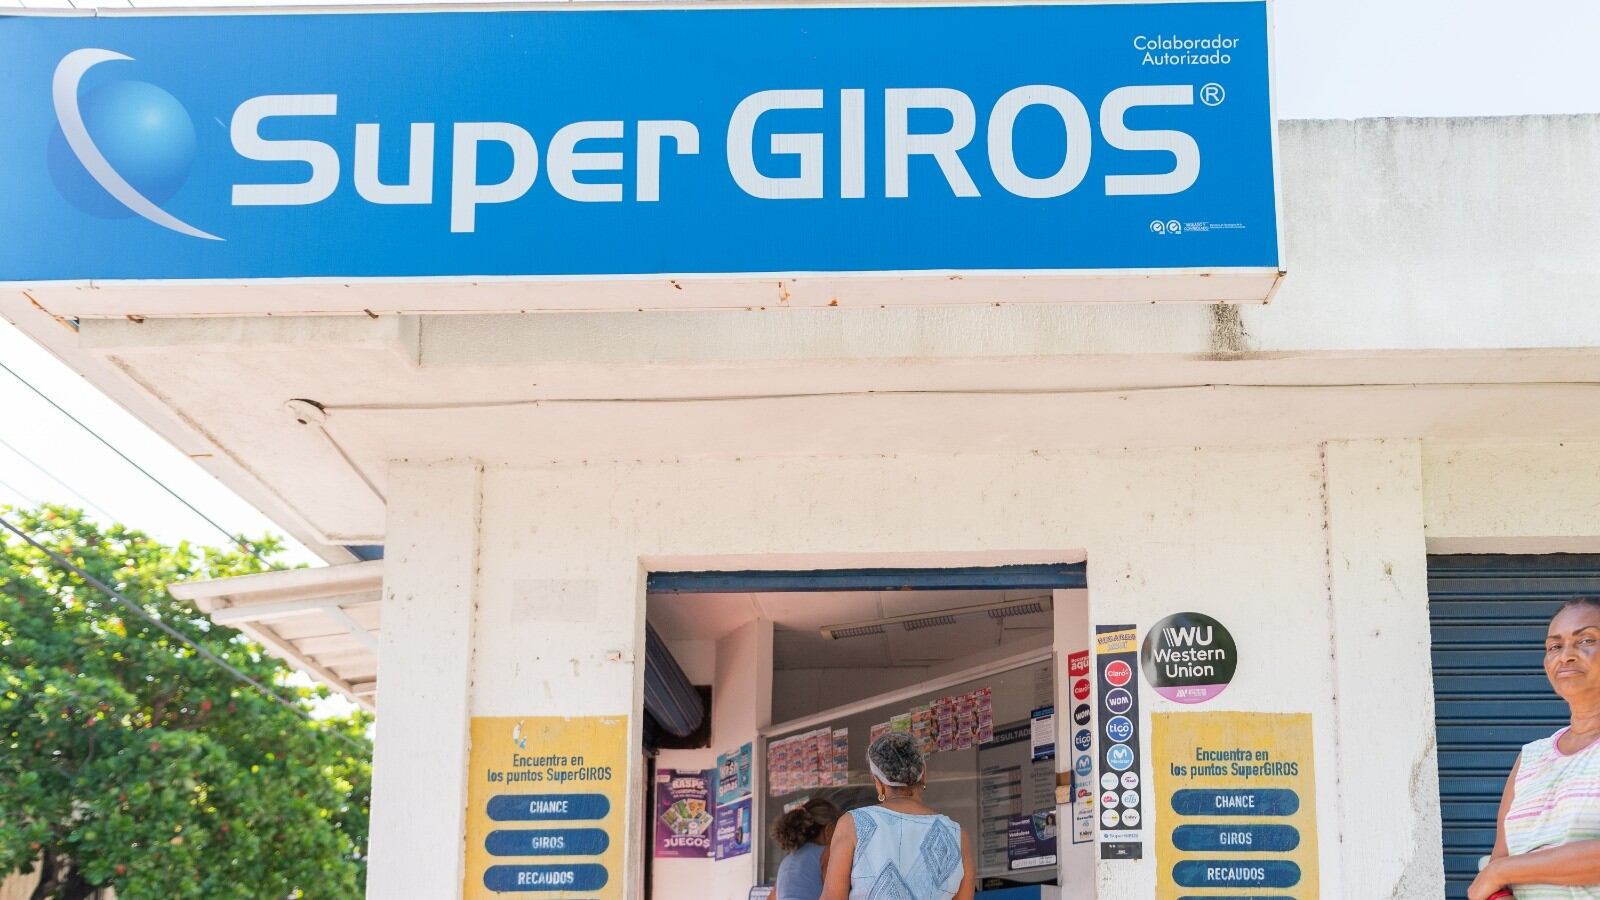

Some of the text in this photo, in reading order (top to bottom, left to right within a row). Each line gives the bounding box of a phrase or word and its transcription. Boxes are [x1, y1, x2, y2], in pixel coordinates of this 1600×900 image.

[1133, 34, 1240, 51] Colaborador
[1142, 50, 1231, 66] Autorizado
[230, 94, 700, 233] Super
[726, 84, 1201, 199] GIROS
[1163, 626, 1213, 647] WU
[1154, 648, 1226, 663] Western
[1166, 662, 1214, 678] Union
[513, 754, 584, 767] Encuentra en
[1196, 747, 1269, 761] Encuentra en
[488, 767, 612, 785] los puntos SuperGIROS
[1171, 762, 1299, 779] los puntos SuperGIROS
[529, 800, 569, 814] CHANCE
[1215, 795, 1255, 808] CHANCE
[532, 836, 564, 849] GIROS
[1219, 832, 1253, 845] GIROS
[517, 871, 575, 885] RECAUDOS
[1207, 867, 1265, 881] RECAUDOS
